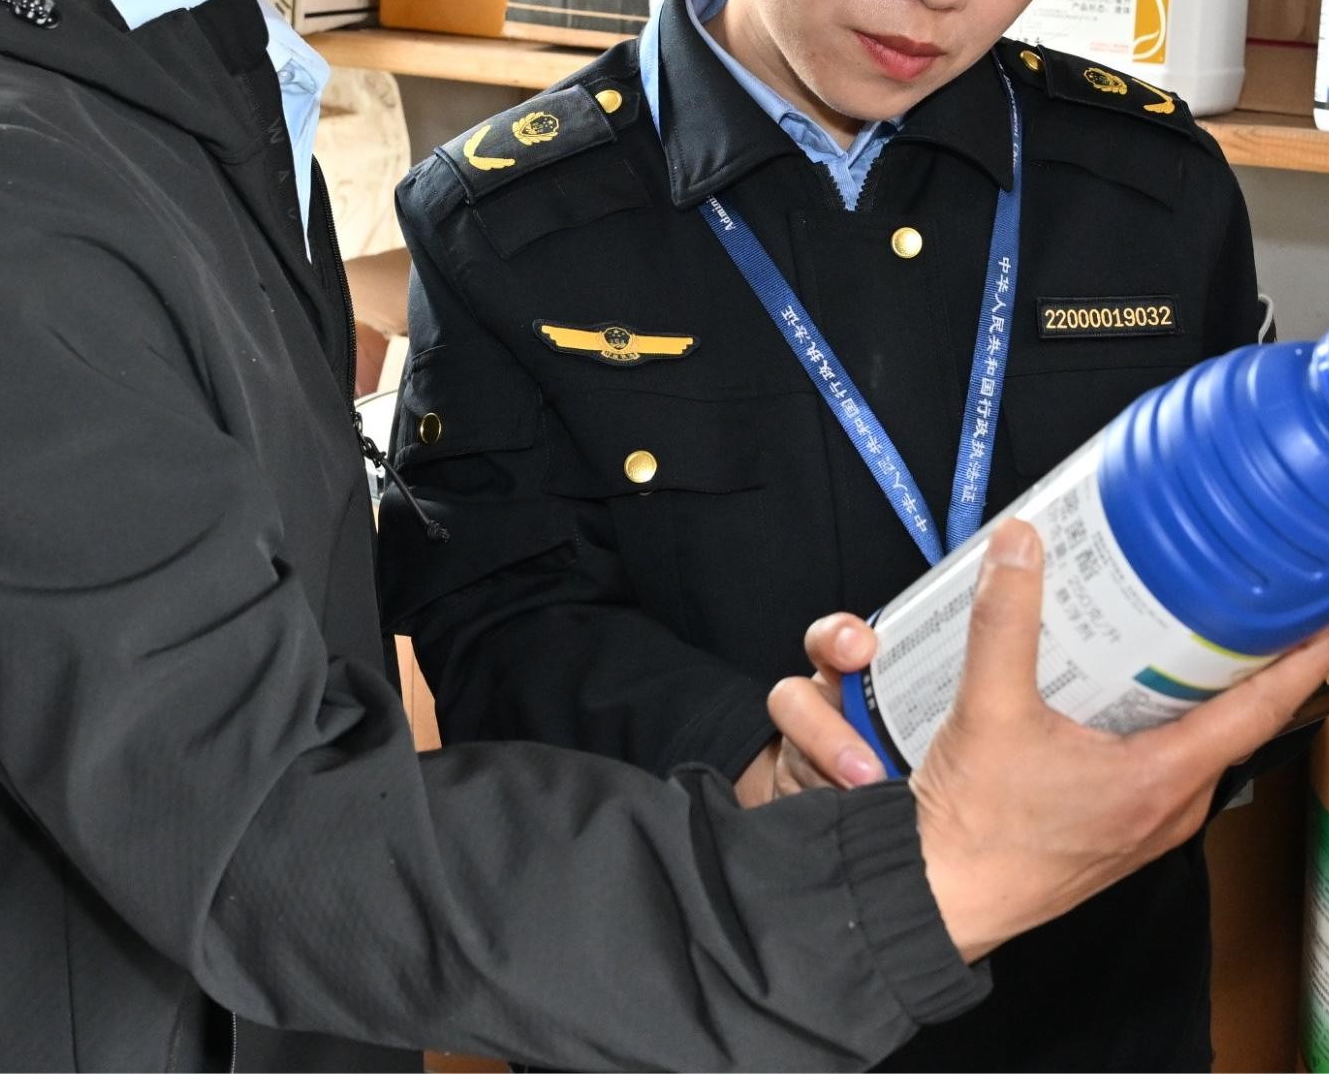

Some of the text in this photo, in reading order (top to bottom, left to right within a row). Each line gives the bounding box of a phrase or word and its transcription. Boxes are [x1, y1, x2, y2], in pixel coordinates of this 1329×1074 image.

[780, 304, 928, 533] 中华人民共和国行政执法证
[960, 256, 1013, 504] 中华人民共和国行政执法证
[1045, 306, 1172, 329] 22000019032
